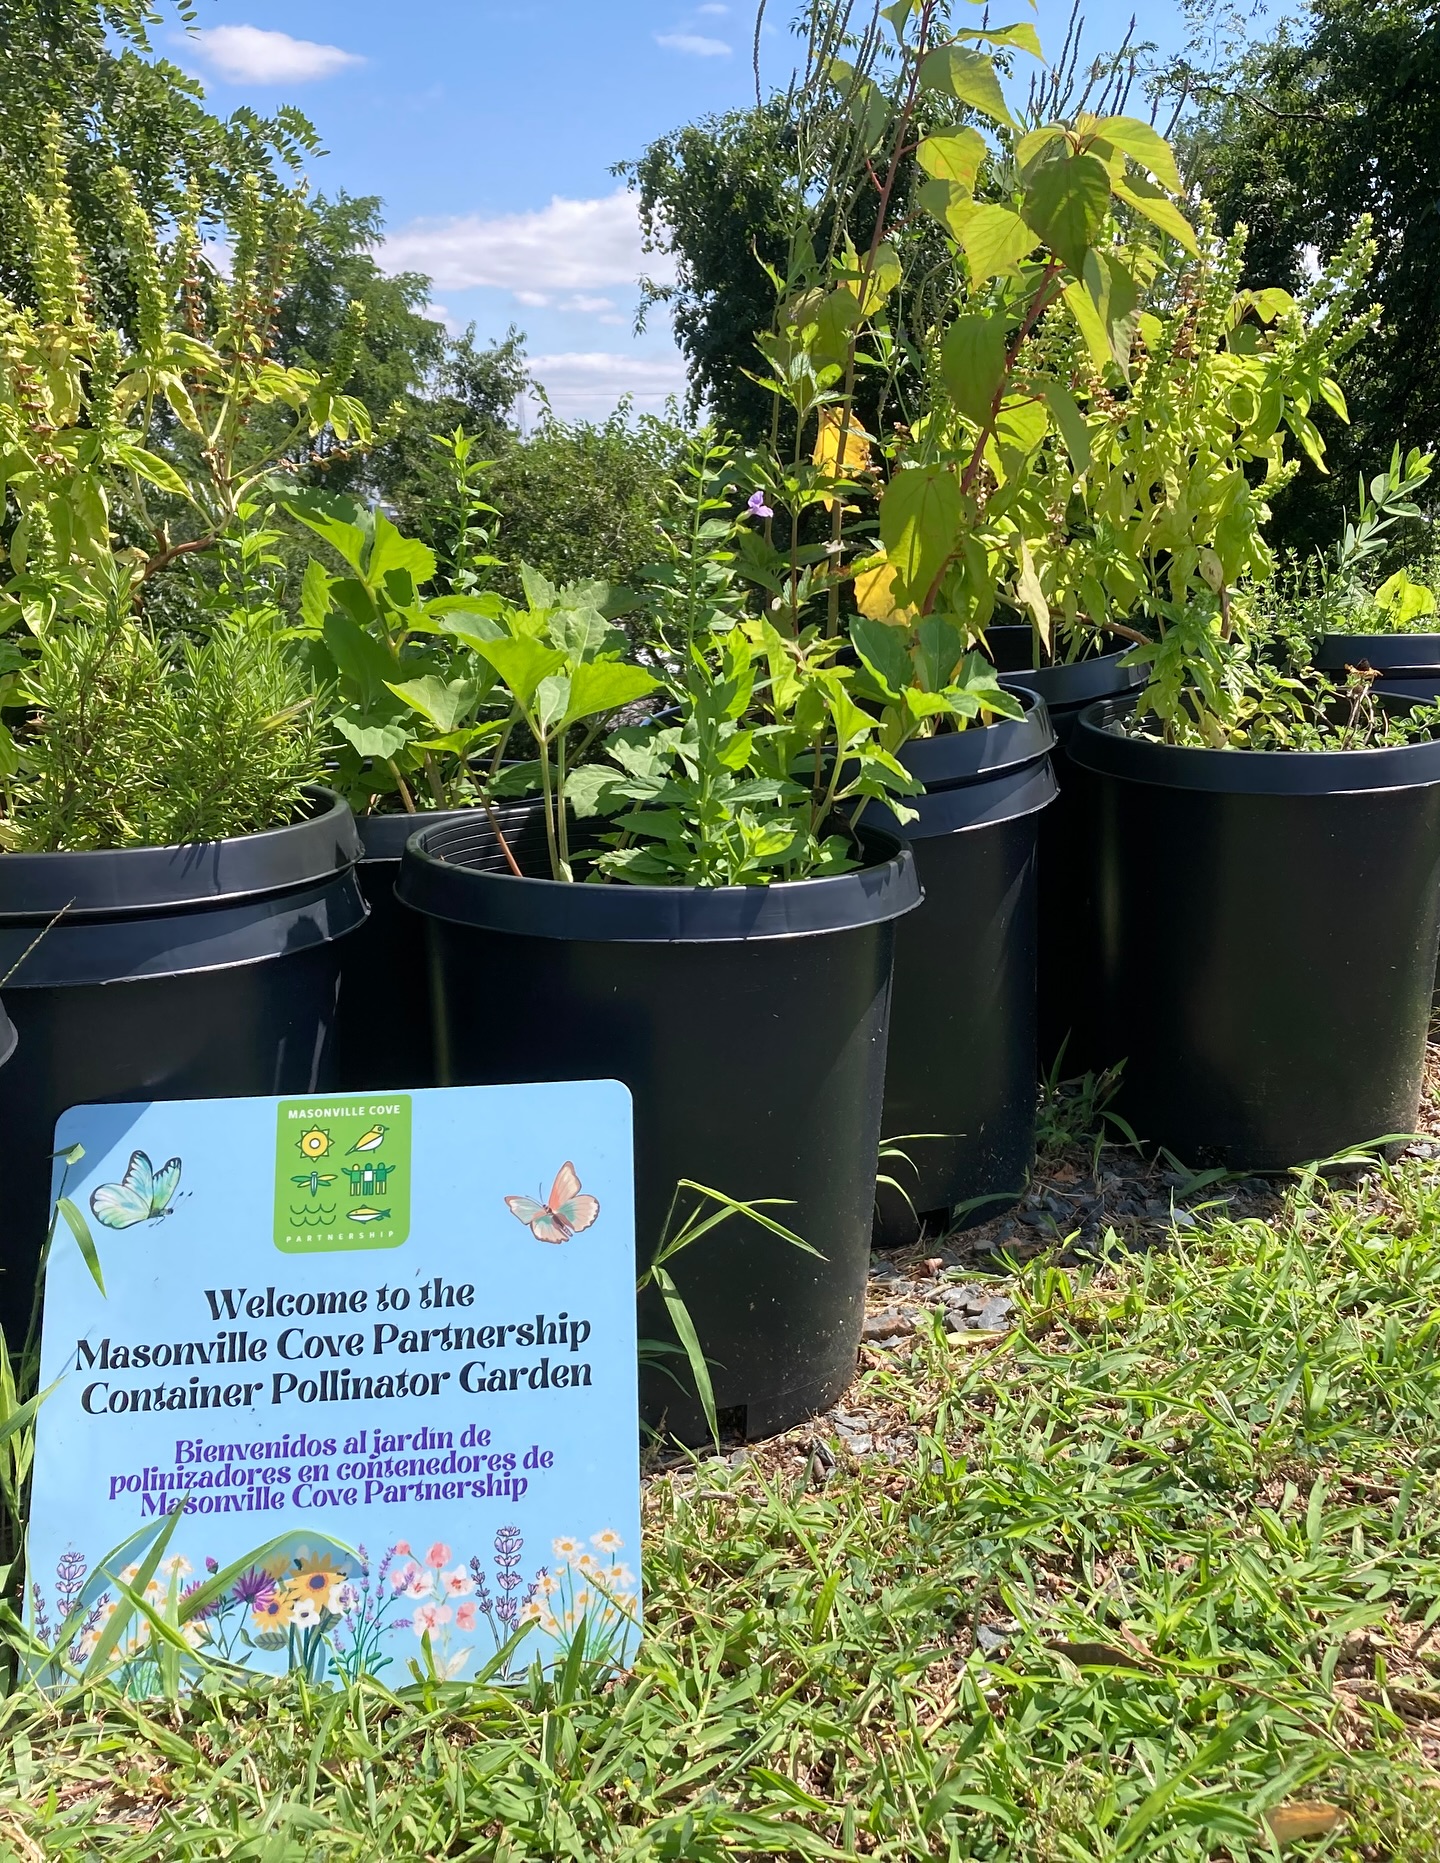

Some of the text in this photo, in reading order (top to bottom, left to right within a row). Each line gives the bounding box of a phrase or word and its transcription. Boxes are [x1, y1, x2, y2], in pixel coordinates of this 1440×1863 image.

[288, 1104, 401, 1119] MASONVILLE COVE
[286, 1230, 394, 1243] PARTNERSHIP
[204, 1277, 475, 1321] Welcome to the
[75, 1311, 591, 1371] Masonville Cove Partnership
[81, 1357, 592, 1415] Container Pollinator Garden
[175, 1423, 491, 1464] Bienvenidos al jardín de
[109, 1445, 554, 1500] polinizadores en contenedores de
[141, 1471, 528, 1517] Masonville Cove Partnership
